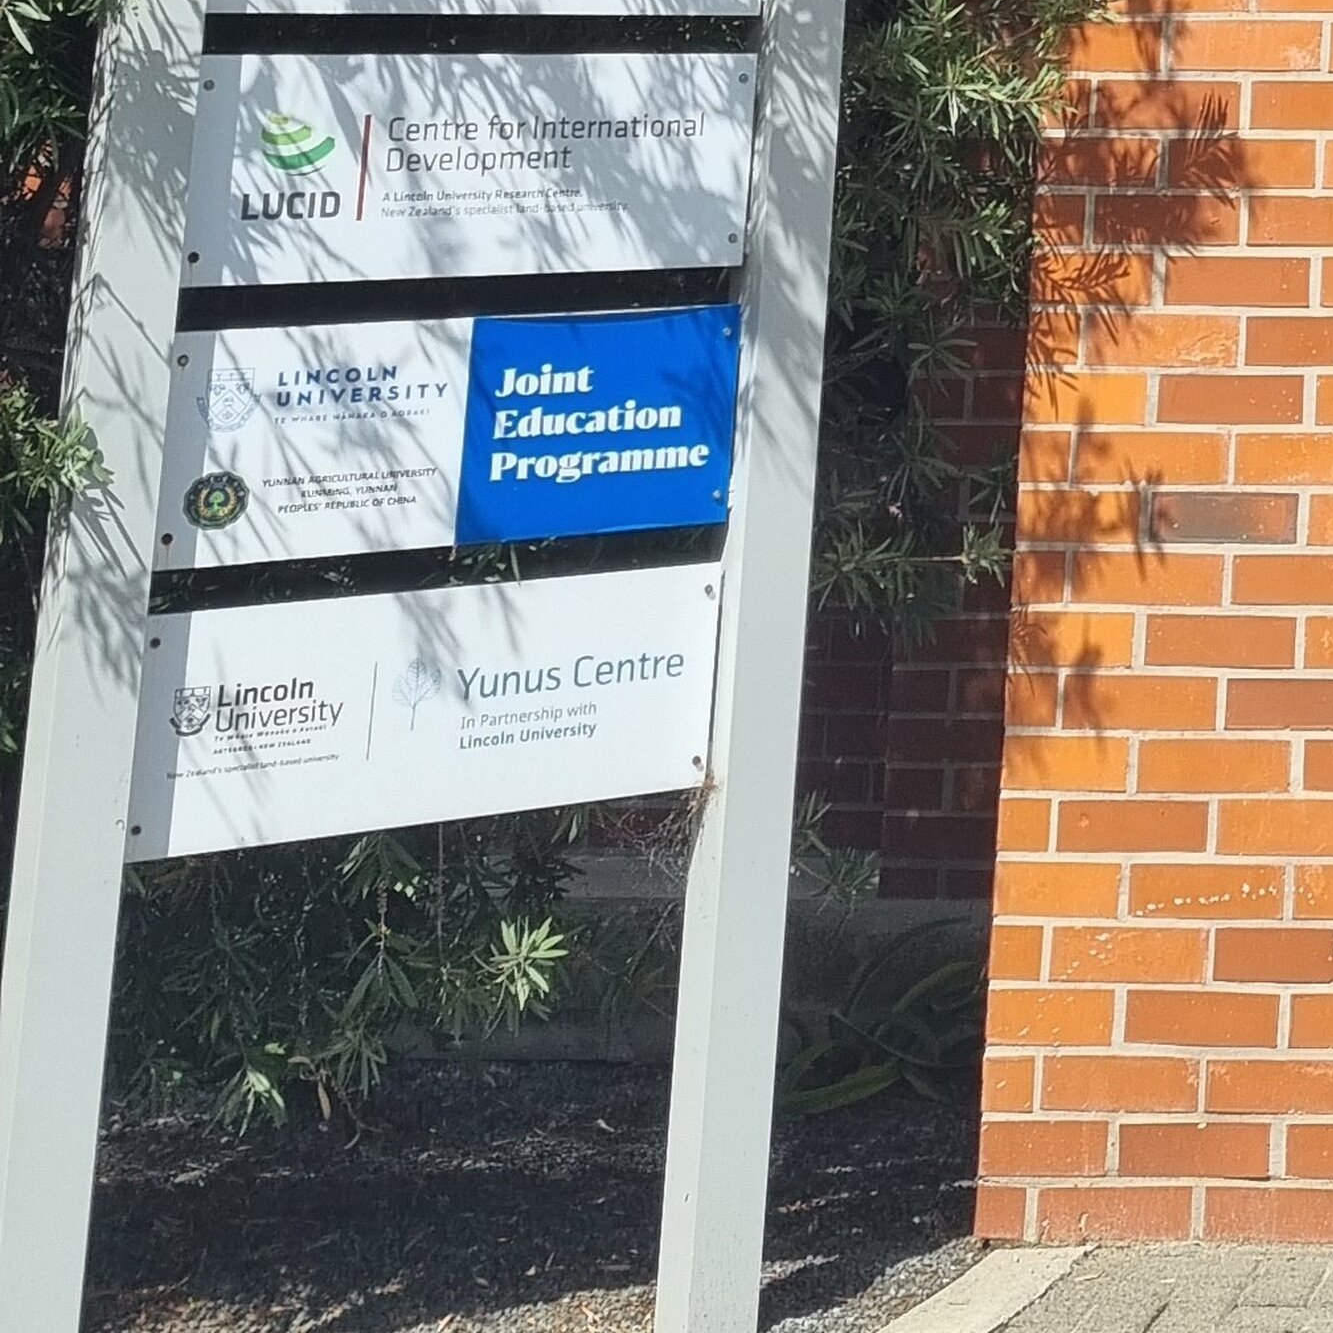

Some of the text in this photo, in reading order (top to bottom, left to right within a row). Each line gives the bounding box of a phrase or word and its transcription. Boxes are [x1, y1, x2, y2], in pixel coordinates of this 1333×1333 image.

[388, 112, 705, 142] Centre for International
[386, 145, 572, 177] Development
[241, 191, 341, 220] LUCID
[278, 365, 397, 386] LINCOLN
[494, 363, 594, 397] Joint
[277, 383, 449, 407] UNIVERSITY
[492, 400, 681, 439] Education
[381, 467, 438, 480] UNIVERSITY
[490, 444, 709, 483] Programme
[372, 498, 385, 508] OF
[387, 496, 416, 507] CHINA
[457, 652, 684, 700] Yunus Centre
[218, 677, 314, 708] Lincoln
[215, 699, 344, 733] University
[461, 702, 597, 730] In Partnership with
[459, 722, 597, 750] Lincoln University
